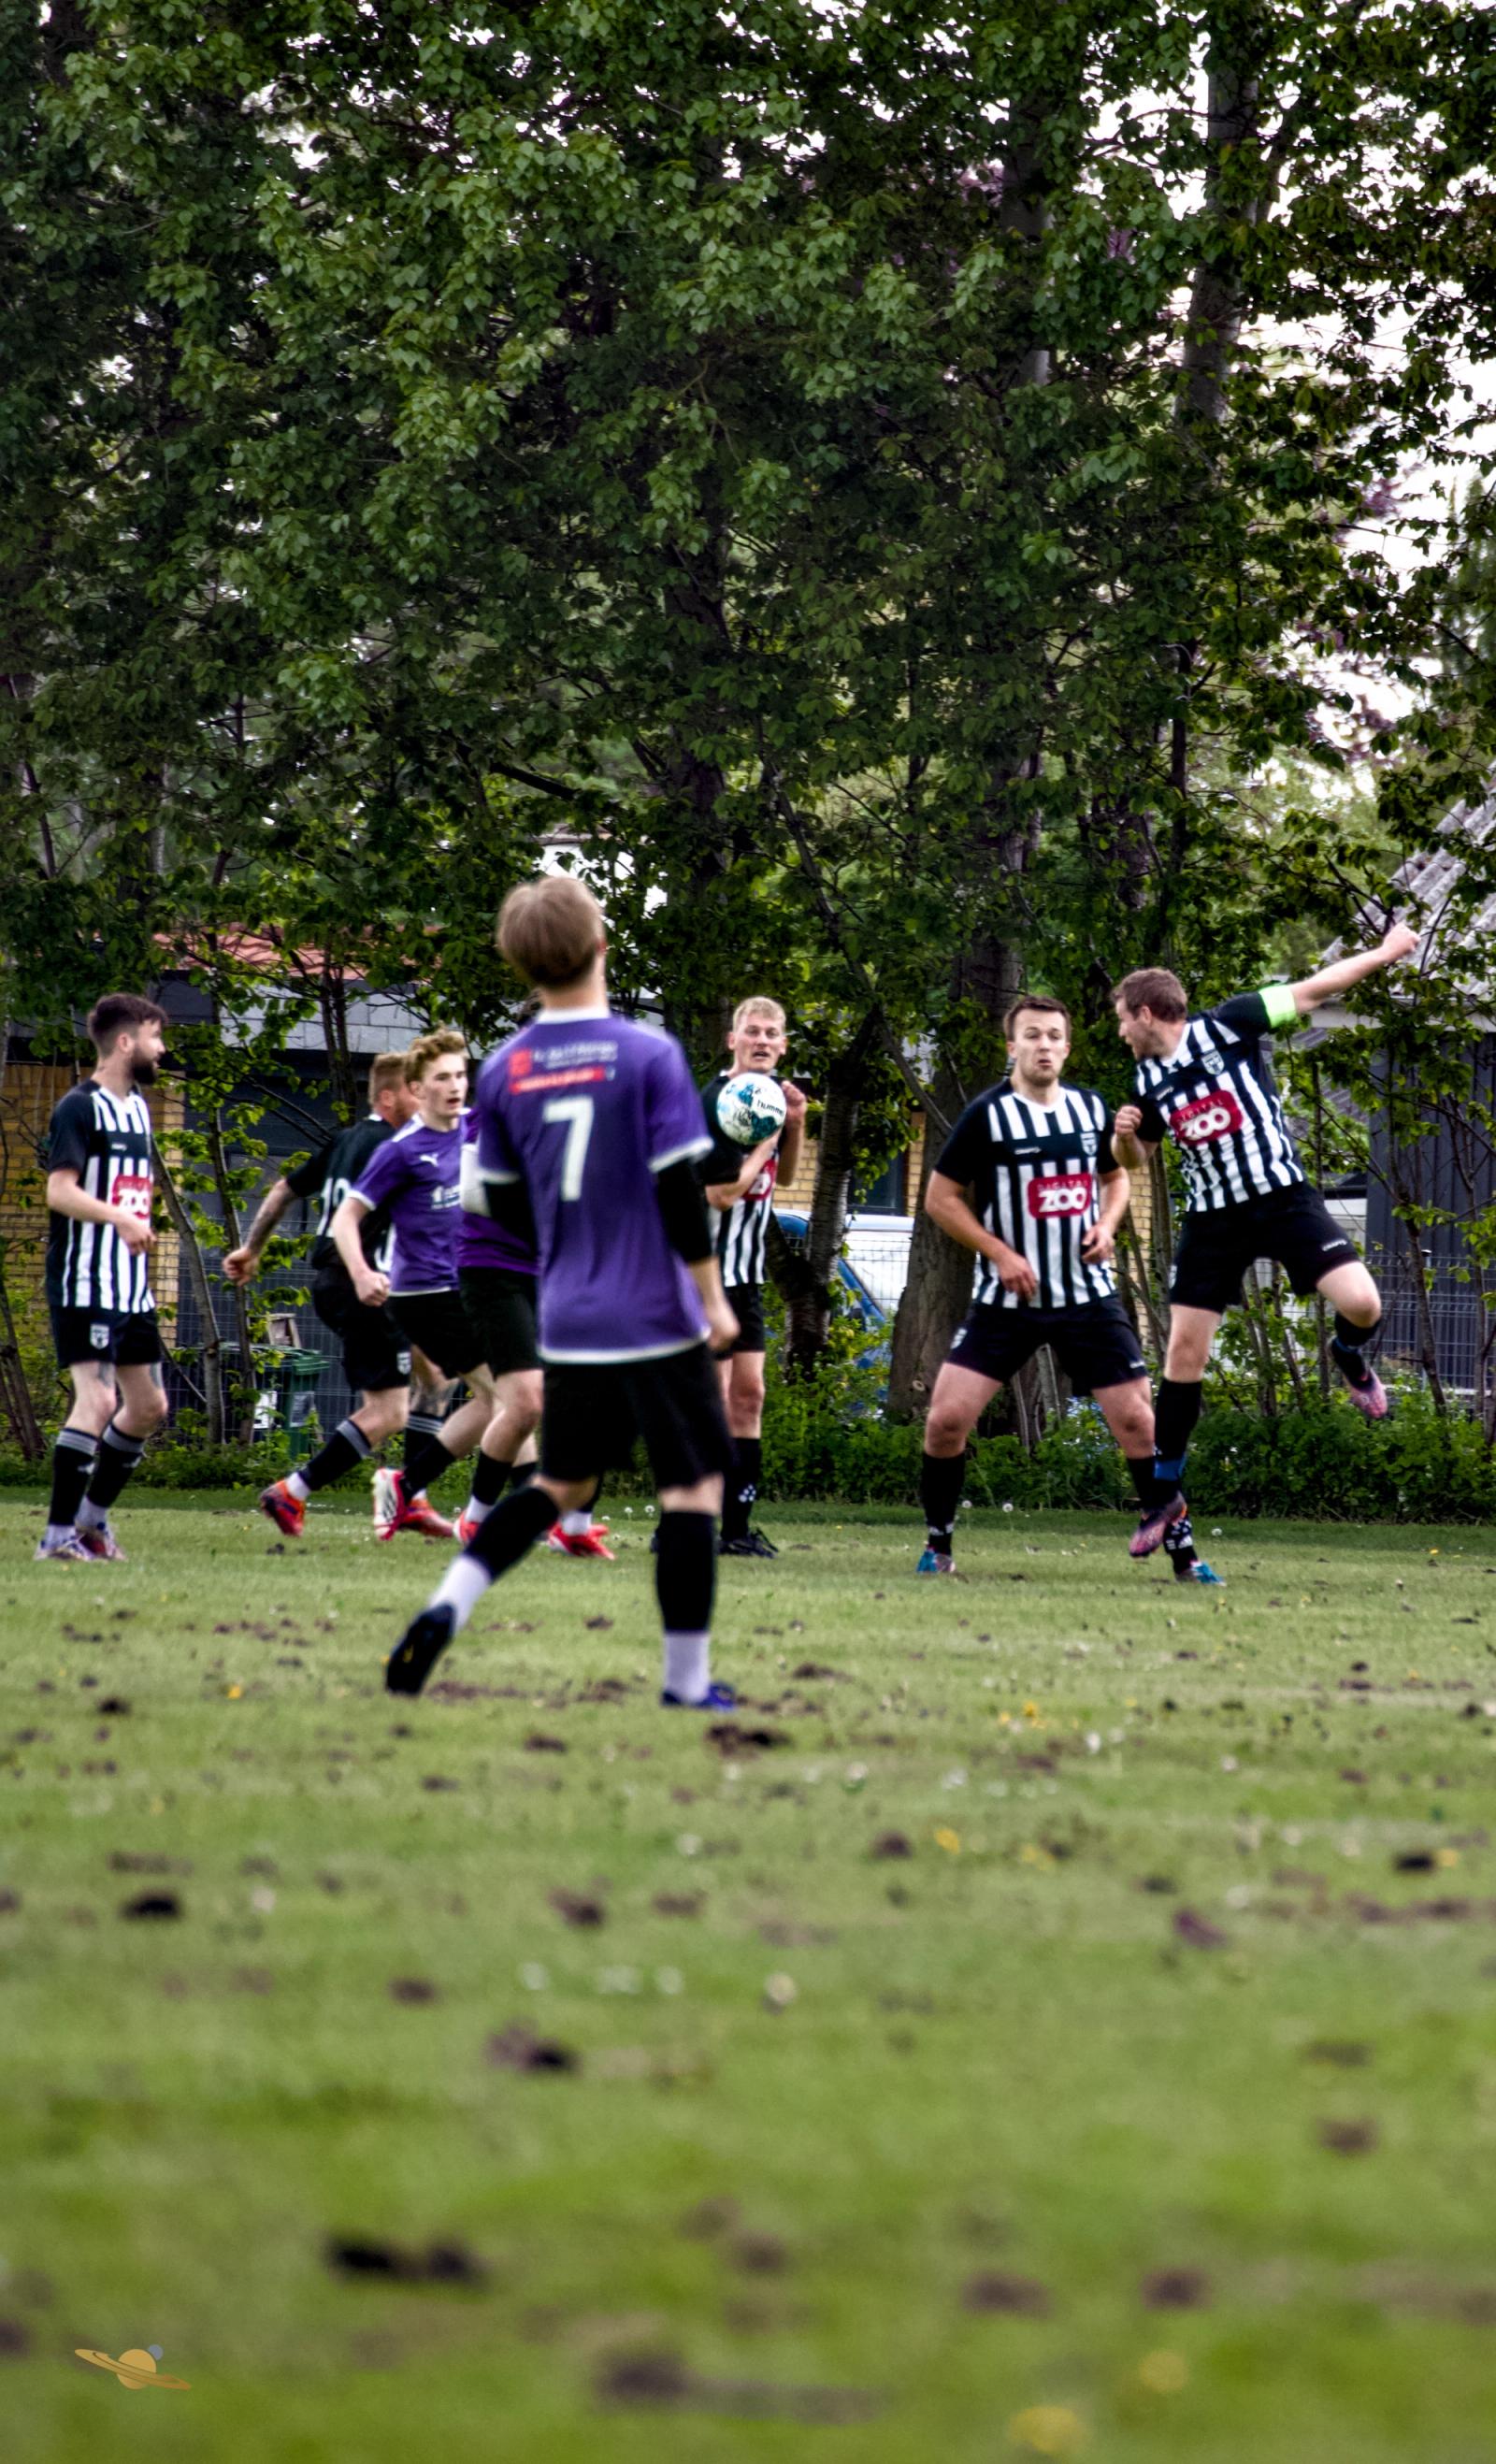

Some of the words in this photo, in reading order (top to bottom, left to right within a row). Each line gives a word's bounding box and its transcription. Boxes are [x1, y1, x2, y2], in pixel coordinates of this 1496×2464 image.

[756, 1099, 784, 1117] humme
[1179, 1107, 1231, 1141] ZOO
[542, 1095, 595, 1203] 7
[1038, 1187, 1087, 1213] ZOO
